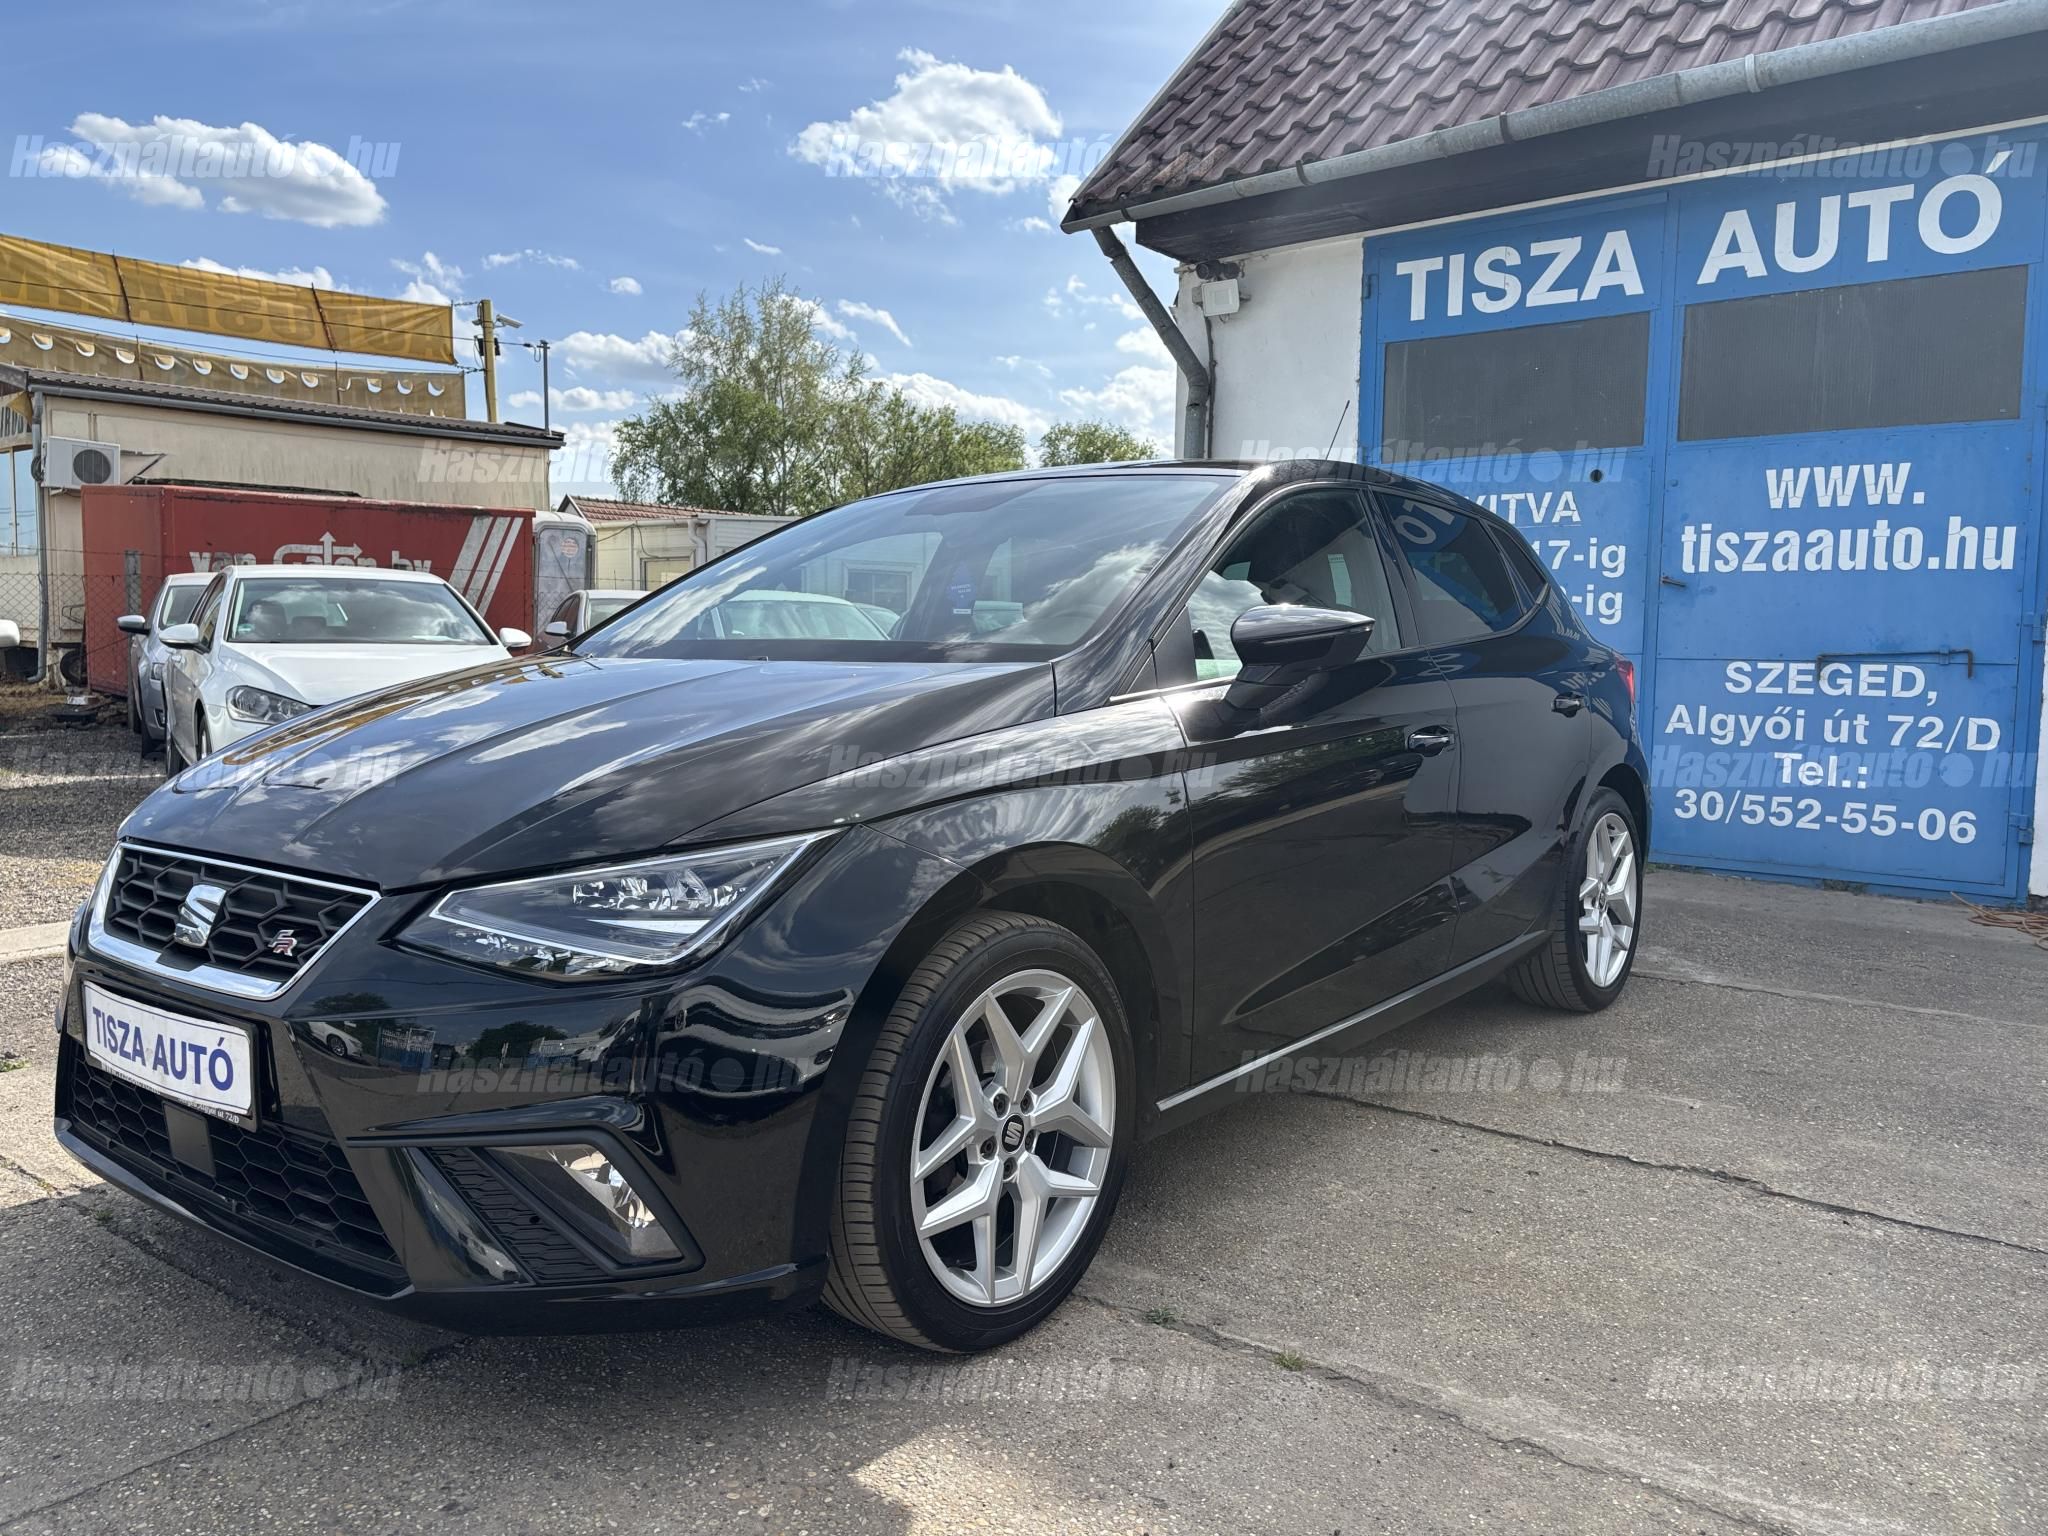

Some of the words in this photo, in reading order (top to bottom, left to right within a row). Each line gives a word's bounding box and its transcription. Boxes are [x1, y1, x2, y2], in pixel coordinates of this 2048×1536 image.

[1396, 229, 1645, 322] TISZA
[1697, 150, 2013, 285] AUTÓ
[1765, 462, 1925, 510] www.
[1681, 515, 2017, 576] tiszaauto.hu
[1560, 584, 1623, 625] -ig
[1724, 661, 1938, 706] SZEGED,
[1664, 704, 1804, 746] Algyői
[1823, 707, 1869, 745] út
[1888, 714, 2001, 752] 72/D
[1773, 752, 1867, 790] Tel.:
[1674, 789, 1977, 845] 30/552-55-06
[92, 1006, 147, 1067] TISZA
[152, 1037, 234, 1091] AUTÓ
